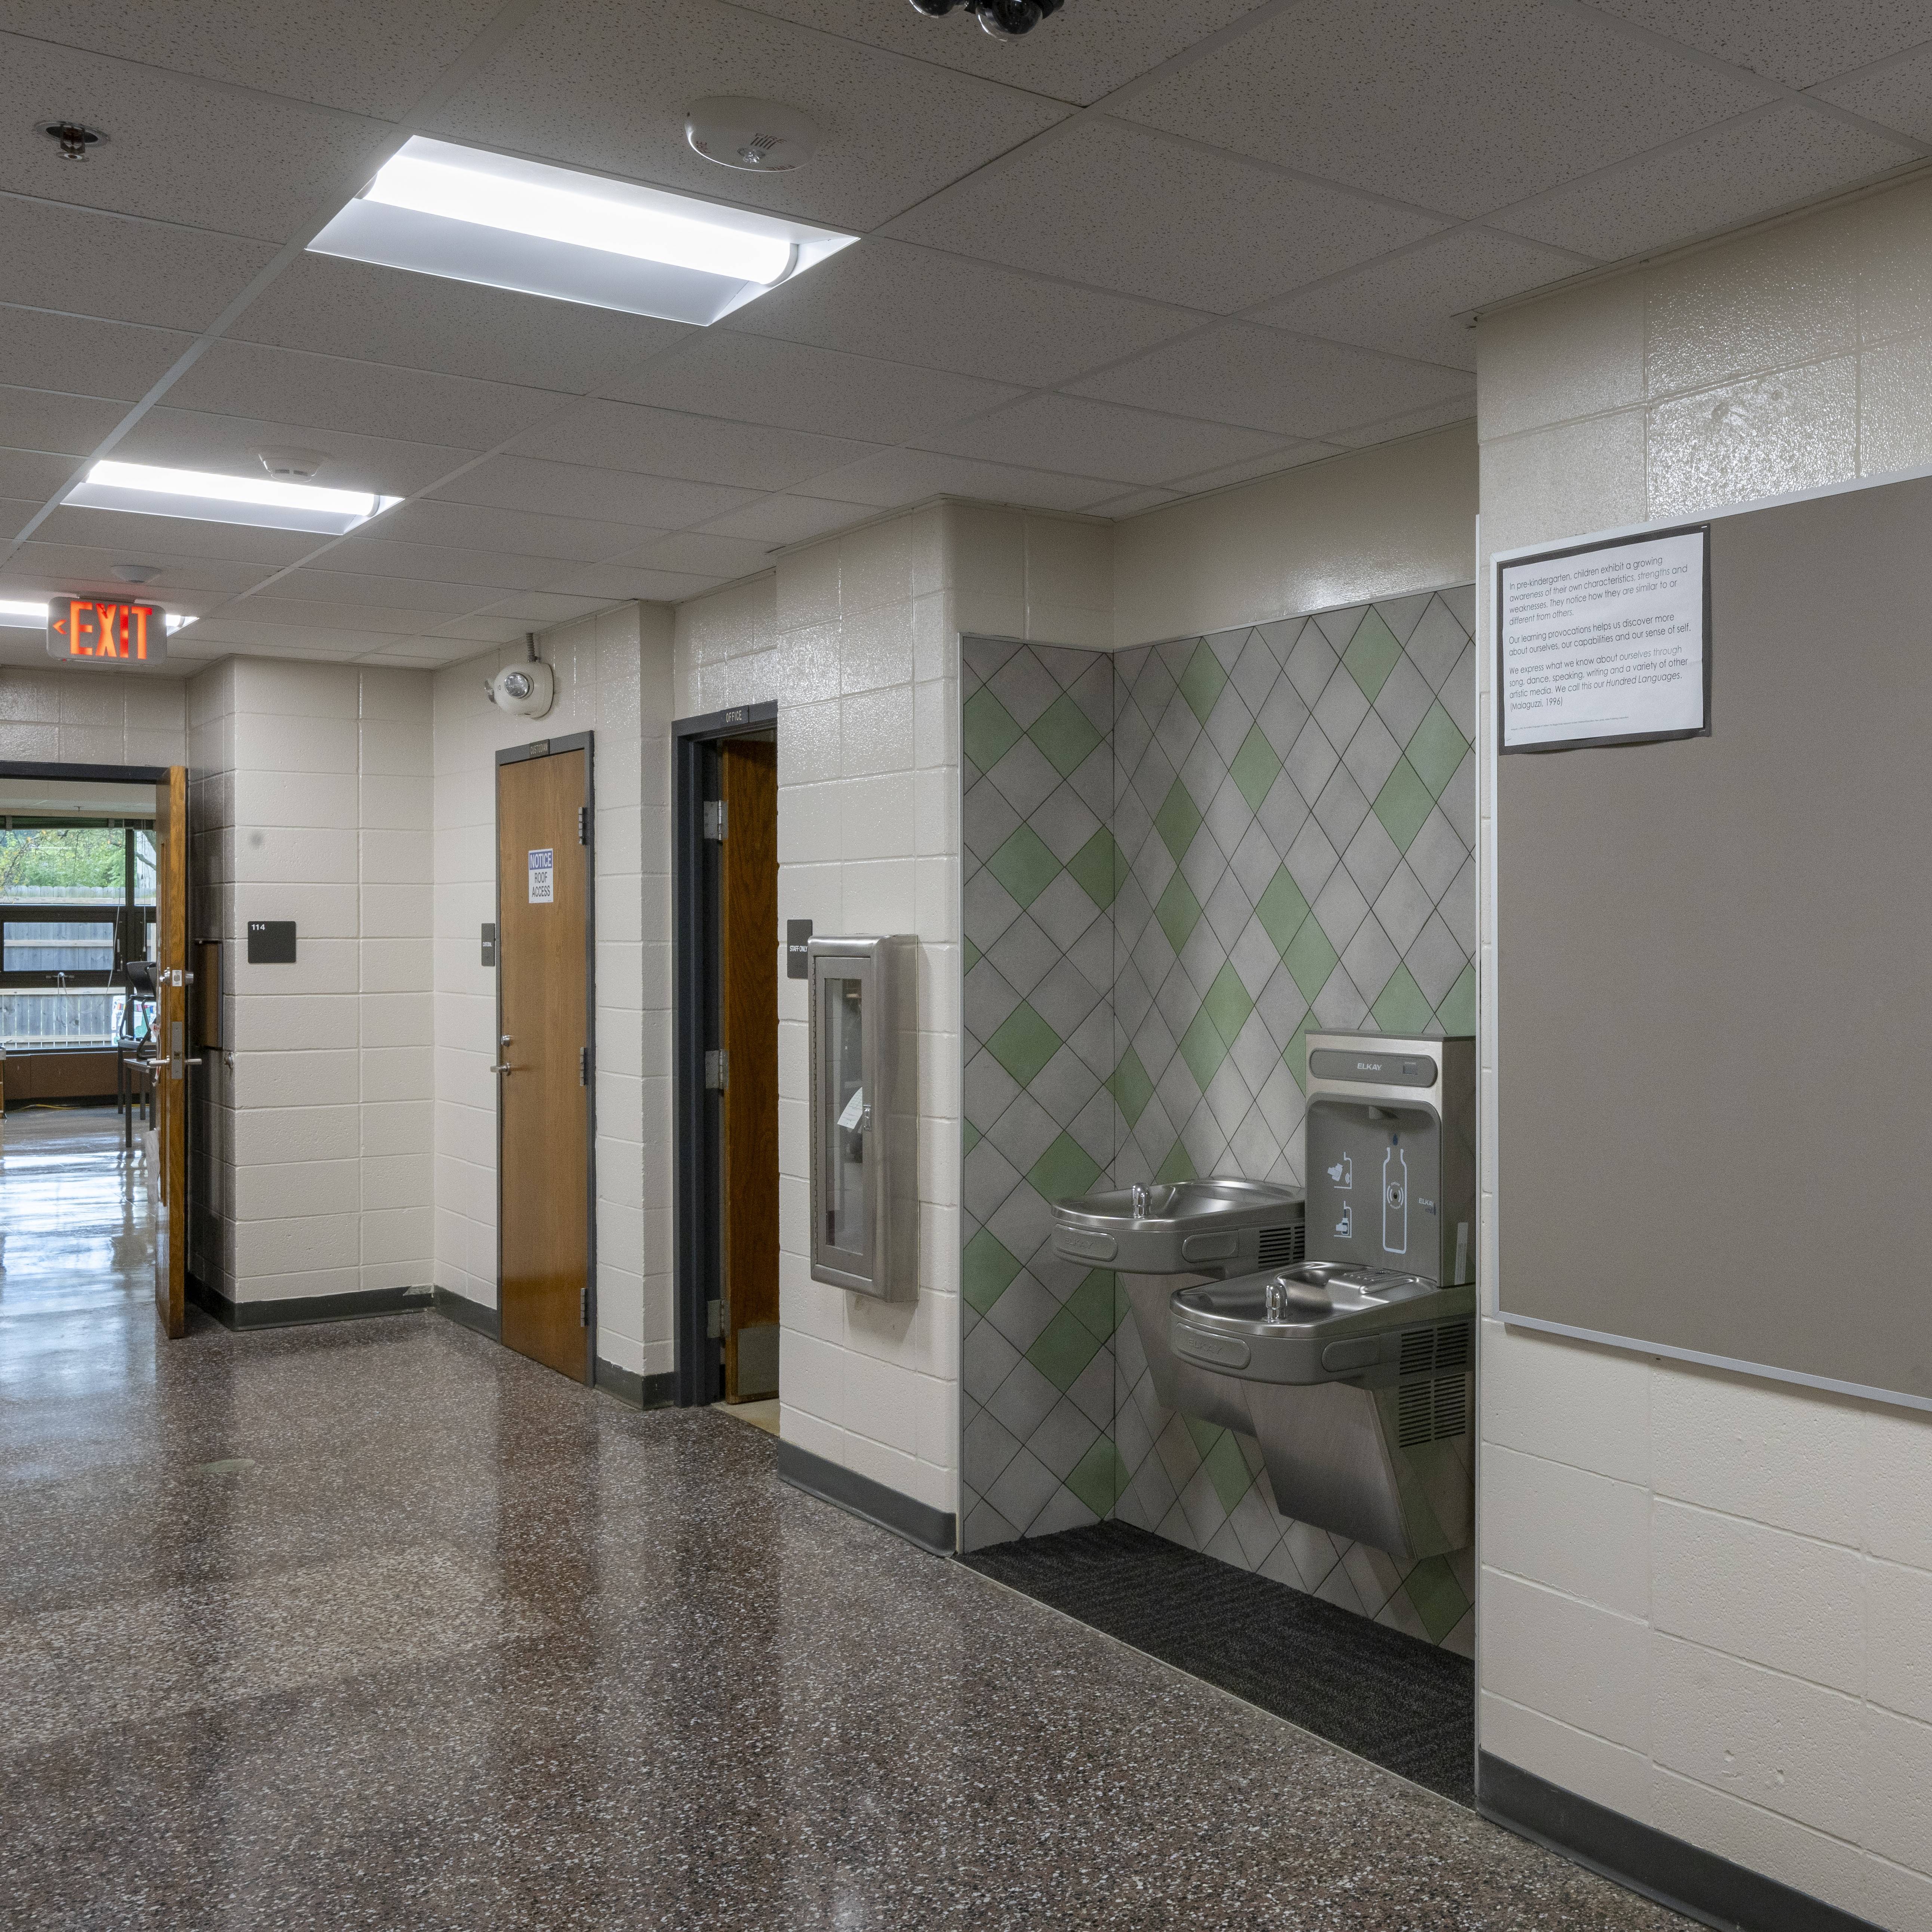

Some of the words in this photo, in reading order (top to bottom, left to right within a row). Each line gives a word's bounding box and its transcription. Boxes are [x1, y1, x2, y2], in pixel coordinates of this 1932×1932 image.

[1510, 591, 1543, 602] awareness
[1545, 587, 1552, 596] of
[1553, 585, 1567, 594] their
[1568, 584, 1582, 592] own
[1584, 574, 1636, 589] characteristics,
[1638, 568, 1670, 580] strengths
[1672, 564, 1688, 575] and
[1517, 574, 1572, 591] pre-kindergarten,
[1573, 568, 1599, 579] children
[1601, 562, 1624, 574] exhibit
[1633, 557, 1662, 570] growing
[1509, 602, 1548, 613] weaknesses.
[1550, 599, 1565, 607] They
[1566, 594, 1587, 604] notice
[1588, 592, 1603, 601] how
[1605, 589, 1621, 598] they
[1636, 582, 1658, 593] similar
[1509, 614, 1535, 625] different
[1536, 613, 1551, 621] from
[1552, 610, 1574, 618] others.
[70, 600, 153, 660] EXIT
[1509, 636, 1520, 644] Our
[1521, 632, 1547, 642] learning
[1548, 625, 1591, 640] provocations
[1593, 622, 1611, 632] helps
[1622, 617, 1653, 628] discover
[1655, 614, 1674, 623] more
[1509, 646, 1528, 656] about
[1529, 643, 1560, 653] ourselves,
[1574, 634, 1613, 647] capabilities
[1615, 631, 1630, 641] and
[1632, 631, 1644, 639] our
[1645, 628, 1665, 637] sense
[1667, 625, 1675, 634] of
[1677, 622, 1691, 633] self.
[1520, 664, 1544, 674] express
[1545, 660, 1563, 670] what
[1576, 658, 1594, 666] know
[1596, 653, 1618, 664] about
[1619, 650, 1651, 661] ourselves
[1653, 645, 1682, 656] through
[1509, 679, 1525, 687] song,
[1526, 676, 1551, 684] dance,
[1552, 671, 1585, 683] speaking,
[1586, 668, 1608, 677] writing
[1610, 665, 1624, 674] and
[1633, 661, 1657, 671] variety
[1659, 659, 1667, 668] of
[1668, 658, 1688, 667] other
[1509, 689, 1528, 699] artistic
[1530, 686, 1553, 696] media.
[1568, 683, 1580, 692] call
[1582, 681, 1592, 690] this
[1606, 675, 1637, 687] Hundred
[1638, 672, 1682, 684] Languages.
[1510, 699, 1543, 712] (Malaguzzi,
[1546, 696, 1563, 707] 1996)
[726, 710, 742, 723] OFFICE
[530, 743, 548, 754] CUSTODIAN
[530, 852, 551, 868] NOTICE
[534, 872, 547, 883] ROOF
[532, 885, 550, 898] ACCESS
[1357, 1063, 1382, 1071] ELKAY
[1418, 1197, 1434, 1207] ELKAY
